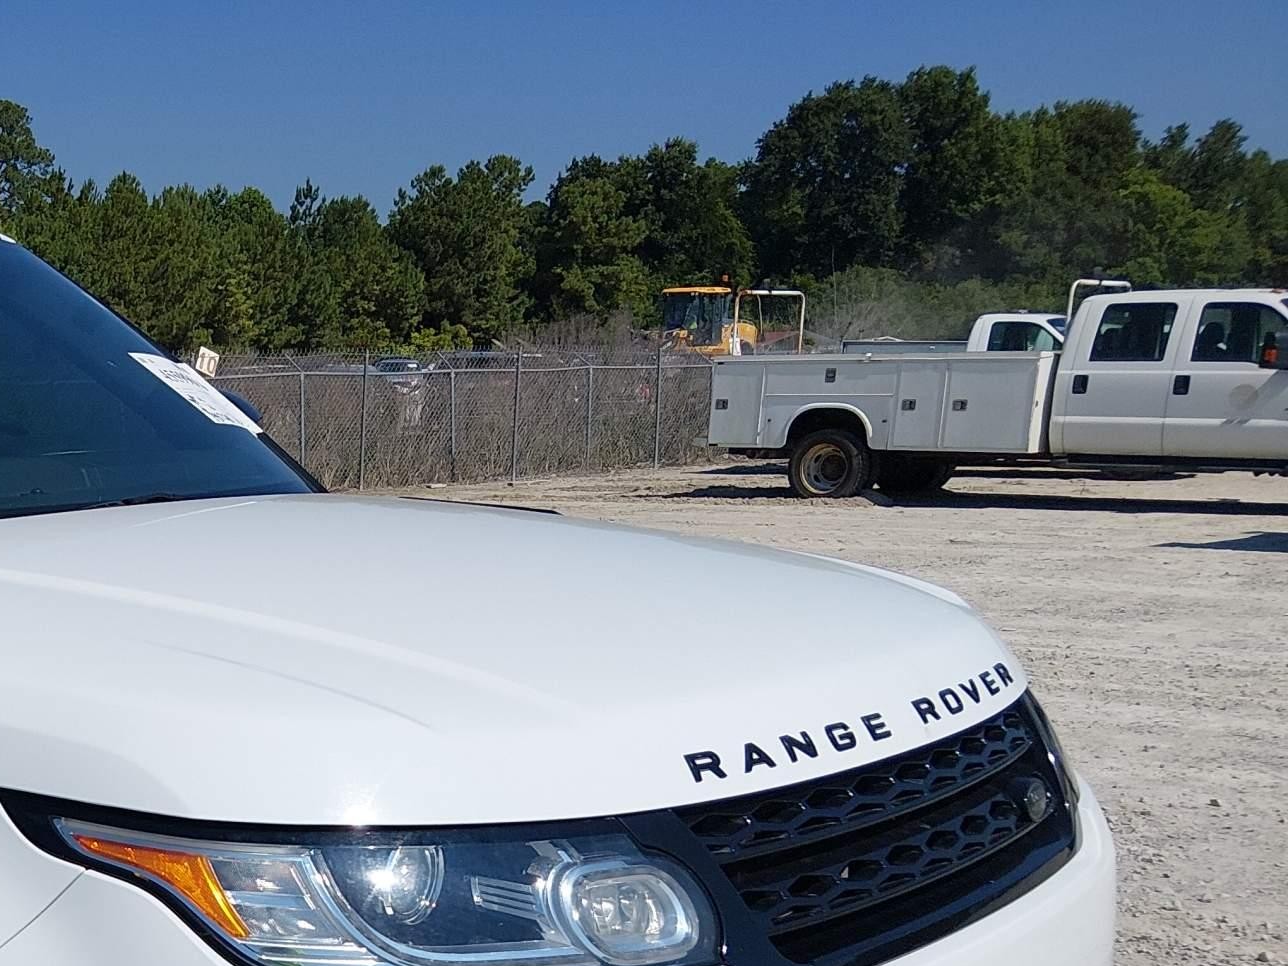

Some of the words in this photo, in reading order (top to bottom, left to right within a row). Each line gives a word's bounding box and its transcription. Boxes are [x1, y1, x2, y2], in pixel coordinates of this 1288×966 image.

[199, 352, 217, 375] 10
[683, 712, 893, 784] RANGE
[911, 661, 1015, 726] ROVER
